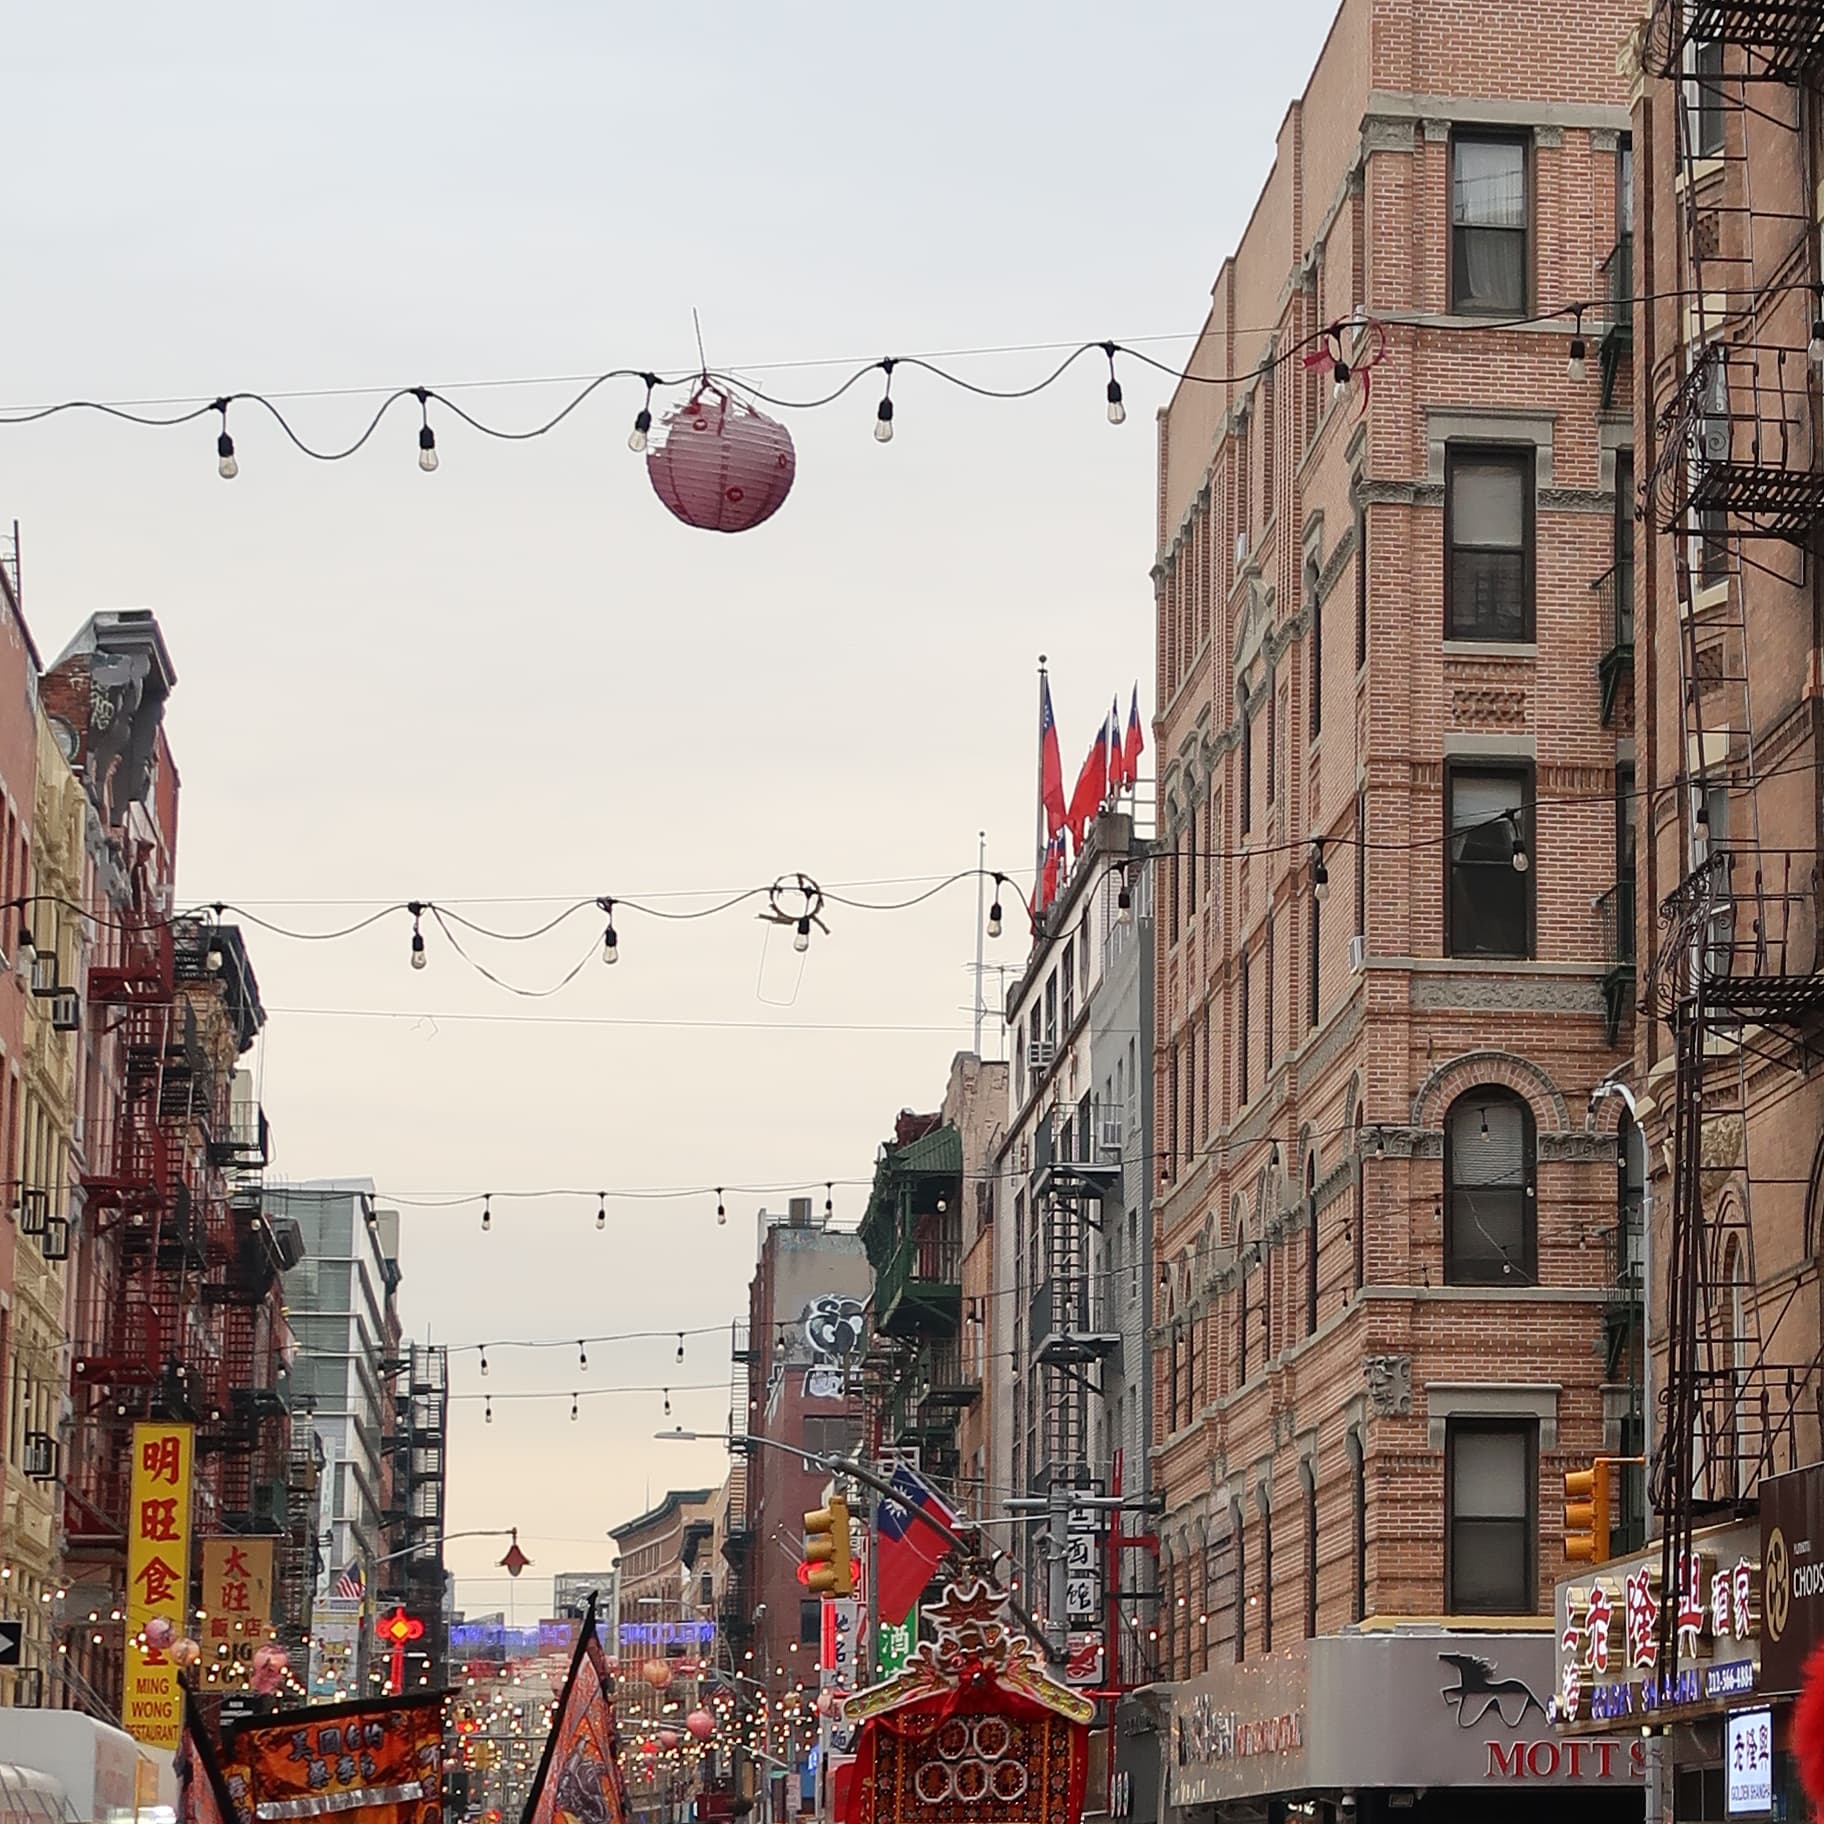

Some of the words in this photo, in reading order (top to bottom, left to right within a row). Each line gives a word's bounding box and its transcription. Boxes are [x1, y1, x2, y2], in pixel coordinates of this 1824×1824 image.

[221, 1545, 252, 1612] 大旺
[136, 1678, 169, 1695] MING
[131, 1701, 172, 1718] WONG
[1483, 1739, 1620, 1777] MOTT
